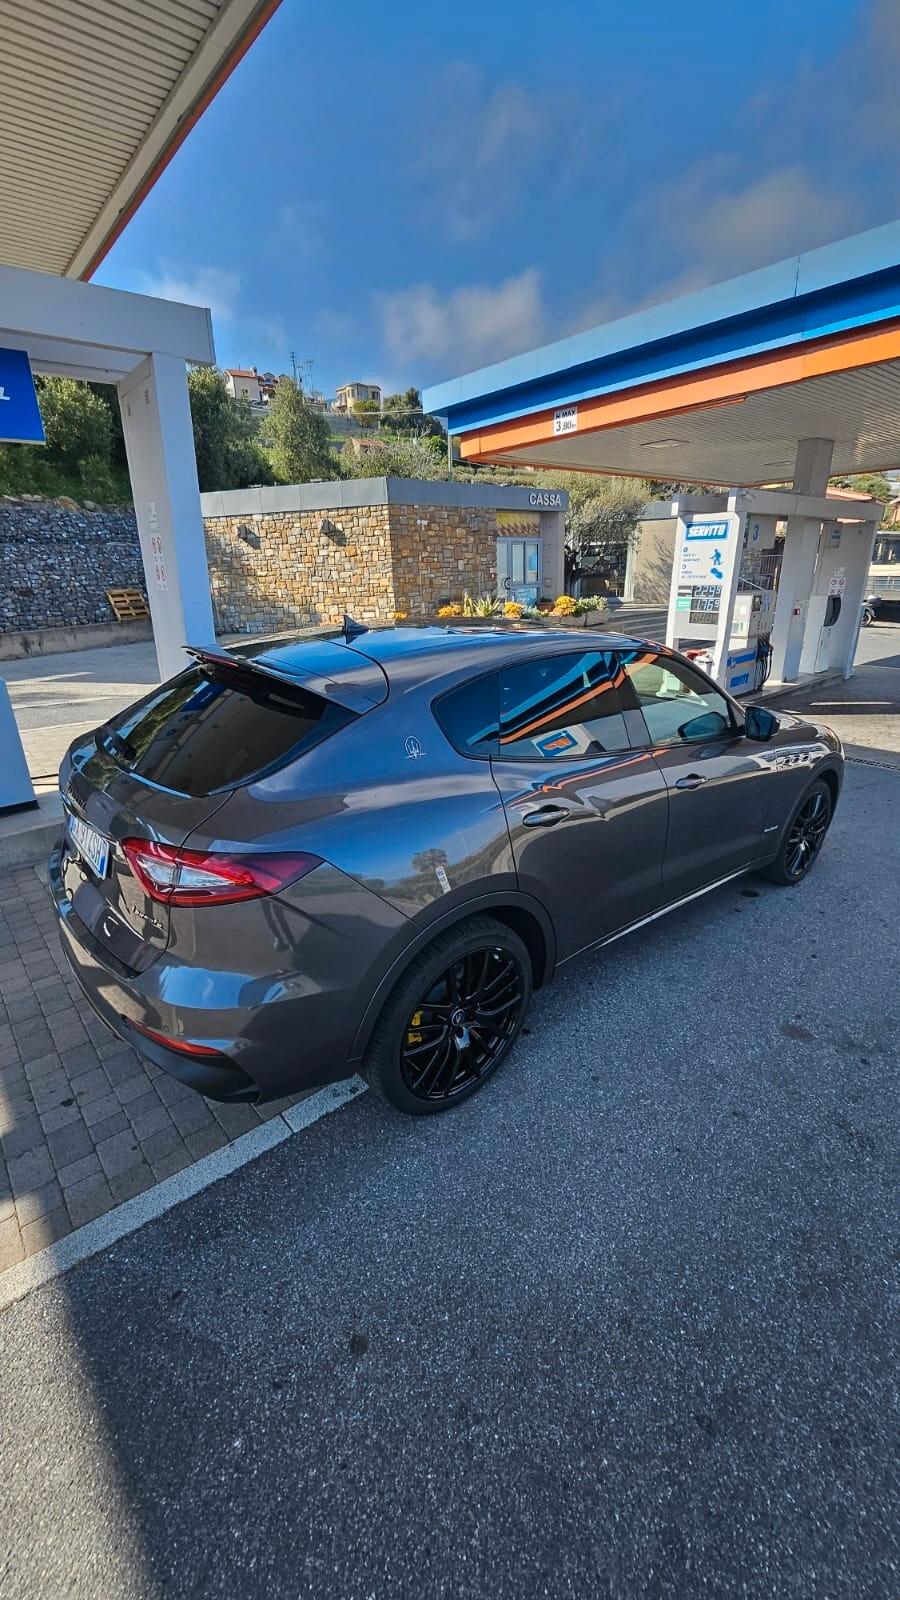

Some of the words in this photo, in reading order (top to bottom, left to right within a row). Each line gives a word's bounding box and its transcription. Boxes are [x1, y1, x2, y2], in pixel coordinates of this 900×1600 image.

[562, 408, 575, 418] MAX
[529, 492, 562, 507] CASSA
[687, 524, 727, 537] SERVITO
[752, 524, 760, 541] 3
